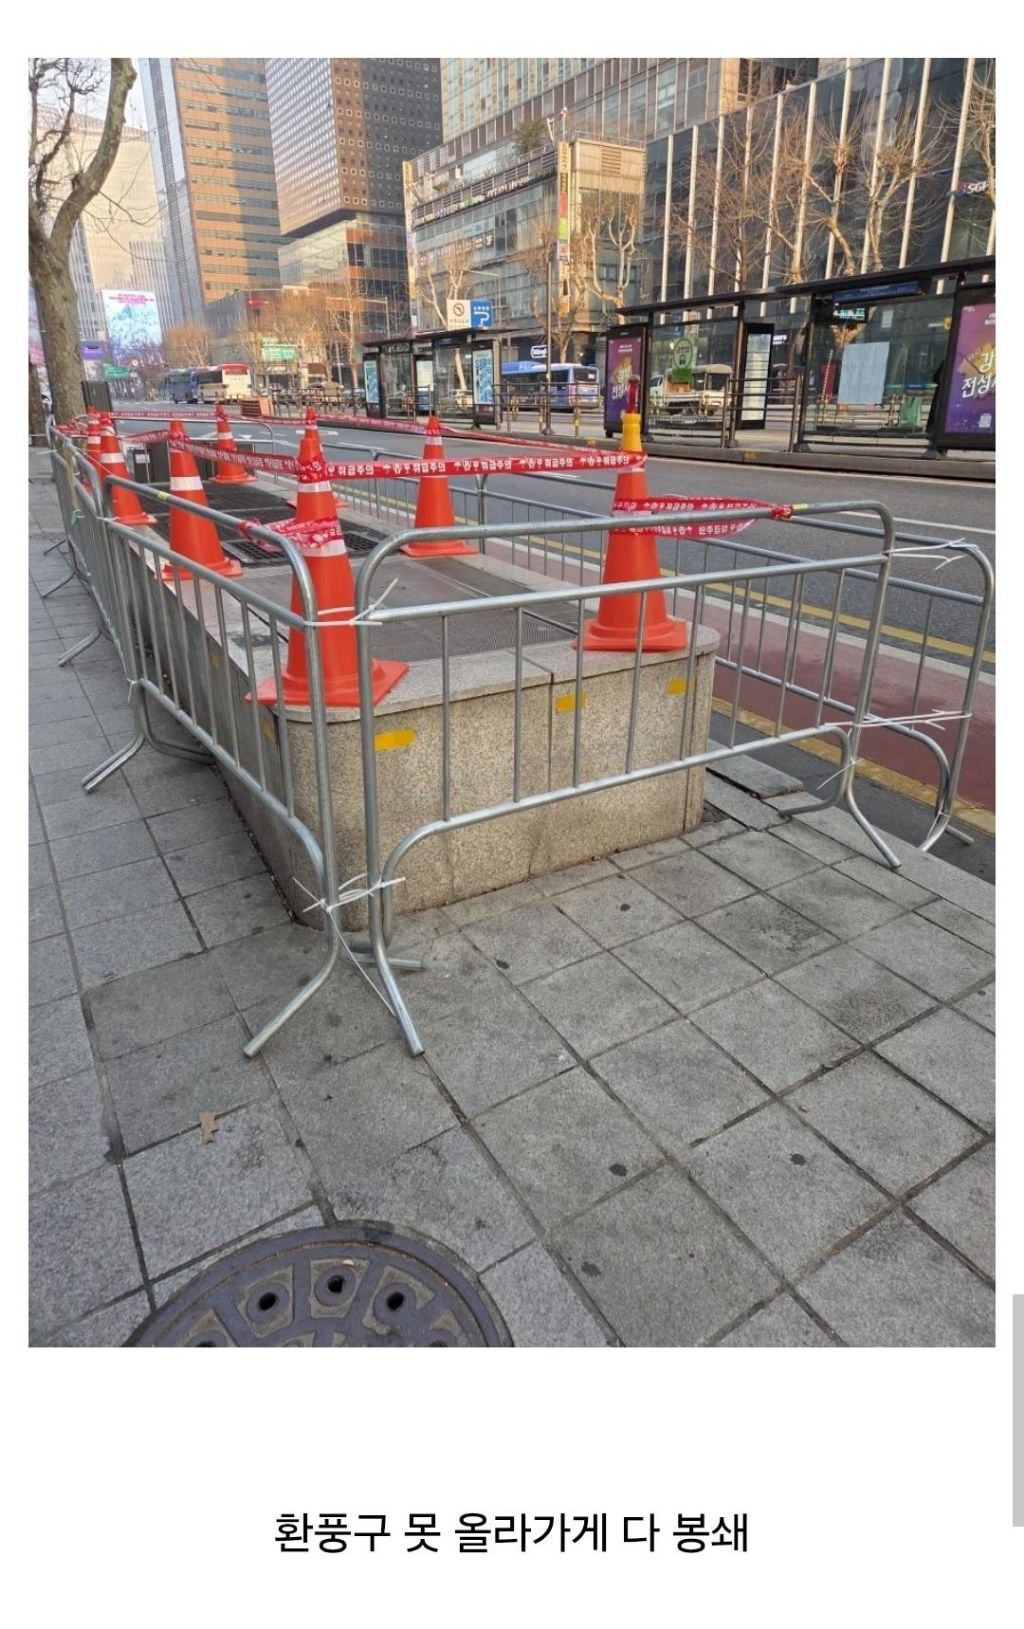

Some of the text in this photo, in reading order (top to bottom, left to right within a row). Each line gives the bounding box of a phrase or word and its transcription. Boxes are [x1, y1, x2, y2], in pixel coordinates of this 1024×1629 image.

[980, 351, 996, 373] 강
[338, 455, 630, 476] 취급주의 취급주의 취급주의 취급주의 취급주의
